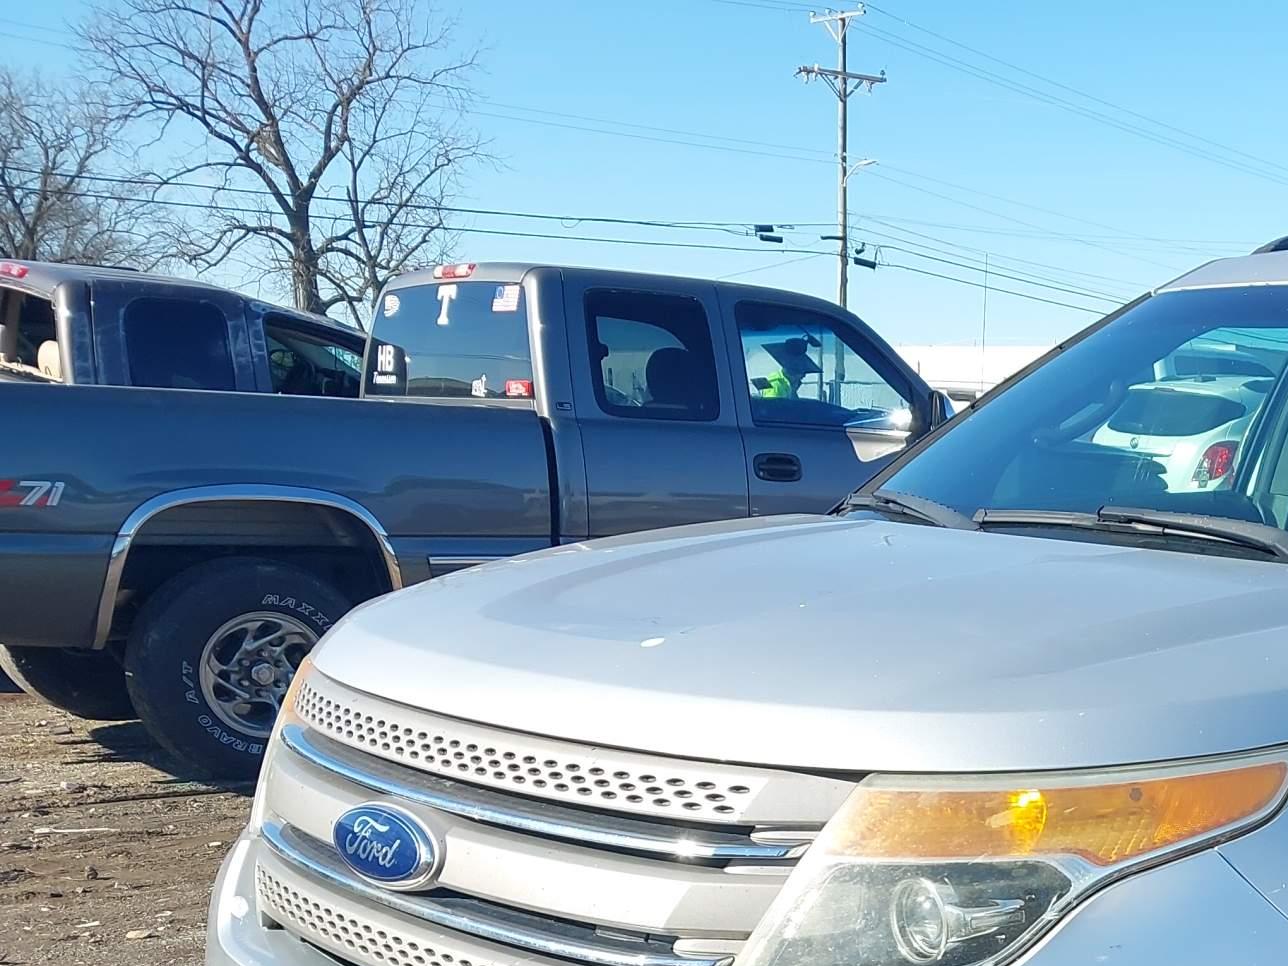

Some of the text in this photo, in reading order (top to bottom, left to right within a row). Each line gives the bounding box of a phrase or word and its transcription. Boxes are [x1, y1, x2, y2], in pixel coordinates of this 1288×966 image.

[262, 594, 333, 630] MAXX
[181, 660, 264, 753] BRAVO A/T
[345, 815, 401, 868] Ford
